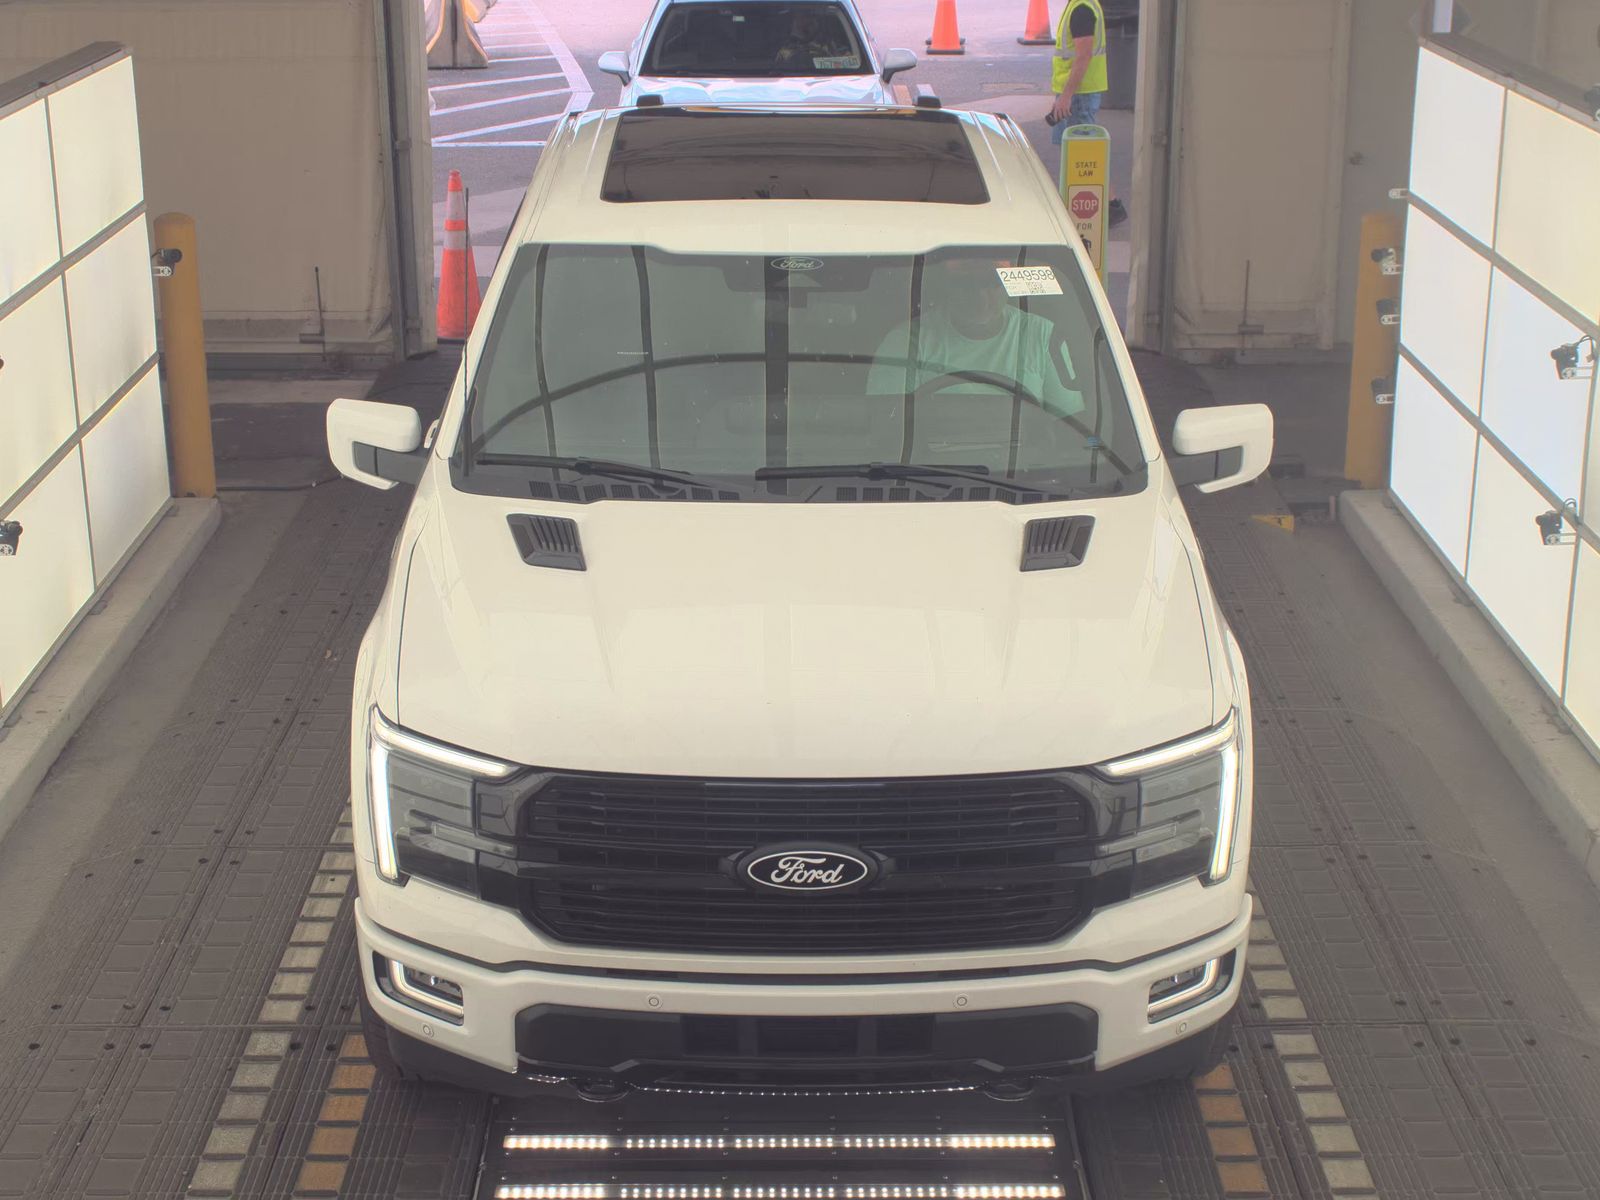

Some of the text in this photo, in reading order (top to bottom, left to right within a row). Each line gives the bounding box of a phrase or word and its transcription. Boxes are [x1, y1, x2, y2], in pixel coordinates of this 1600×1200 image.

[1075, 161, 1097, 169] STATE
[1072, 199, 1098, 211] STOP
[1076, 222, 1092, 230] FOR
[1000, 269, 1055, 282] 2449598
[770, 856, 845, 884] Ford
